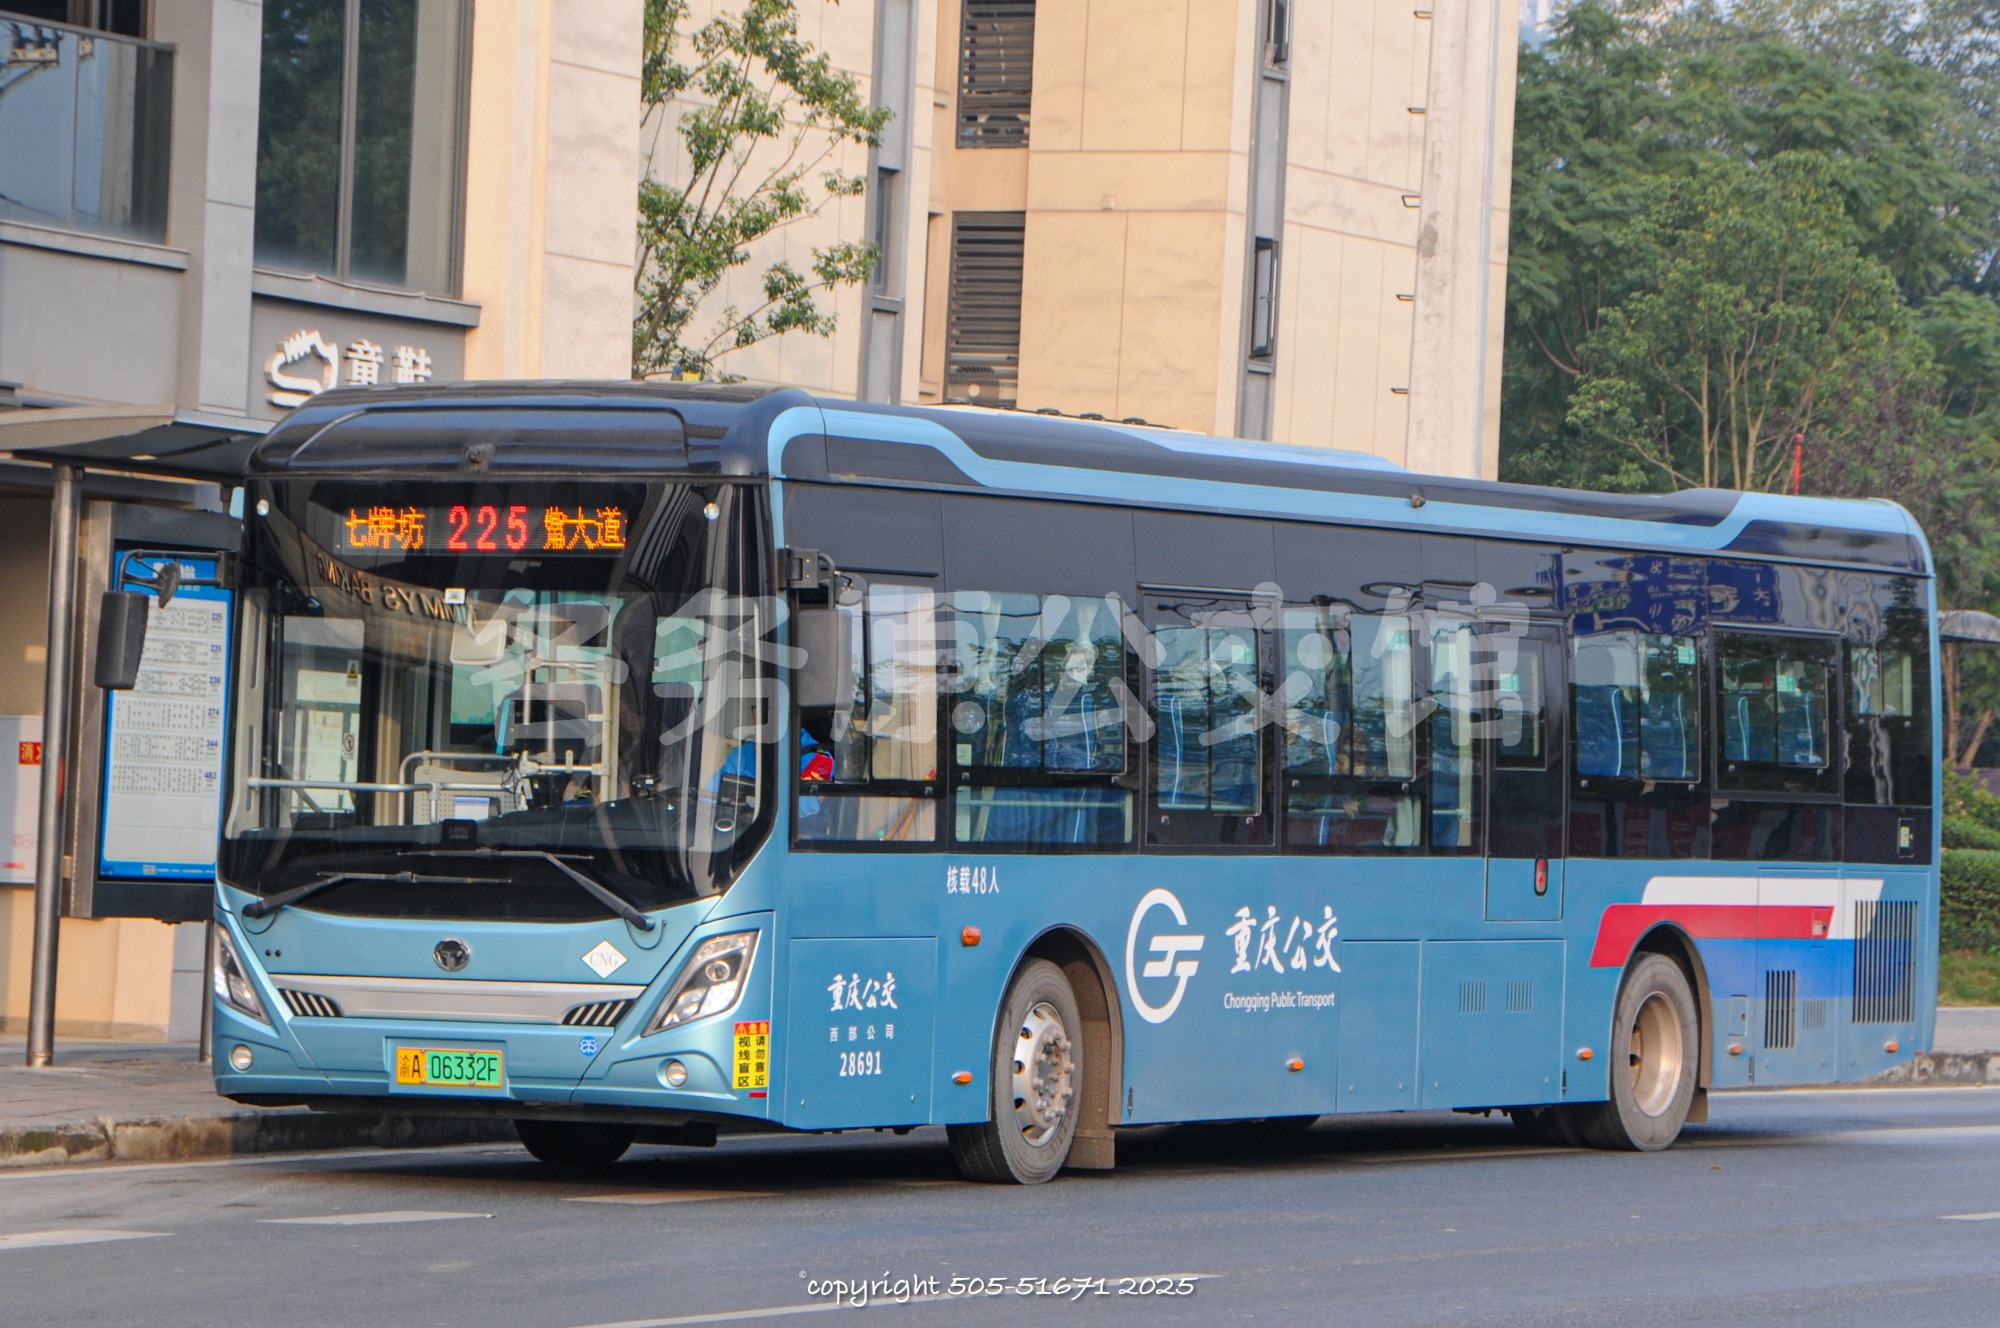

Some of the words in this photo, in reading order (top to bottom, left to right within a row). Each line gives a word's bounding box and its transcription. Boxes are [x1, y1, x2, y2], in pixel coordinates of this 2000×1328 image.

[345, 338, 432, 385] 童鞋
[447, 505, 528, 551] 225
[946, 866, 1000, 894] 核载48人
[590, 952, 618, 967] CNG
[1225, 905, 1341, 974] 重庆公交
[827, 971, 898, 1012] 重庆公交
[1223, 993, 1270, 1012] Chongqing
[1271, 991, 1296, 1008] Public
[1297, 991, 1335, 1010] Transport
[829, 1023, 895, 1042] 西部公司
[738, 1036, 751, 1087] 视线盲区
[755, 1035, 766, 1086] 请勿靠近
[839, 1050, 882, 1076] 28691
